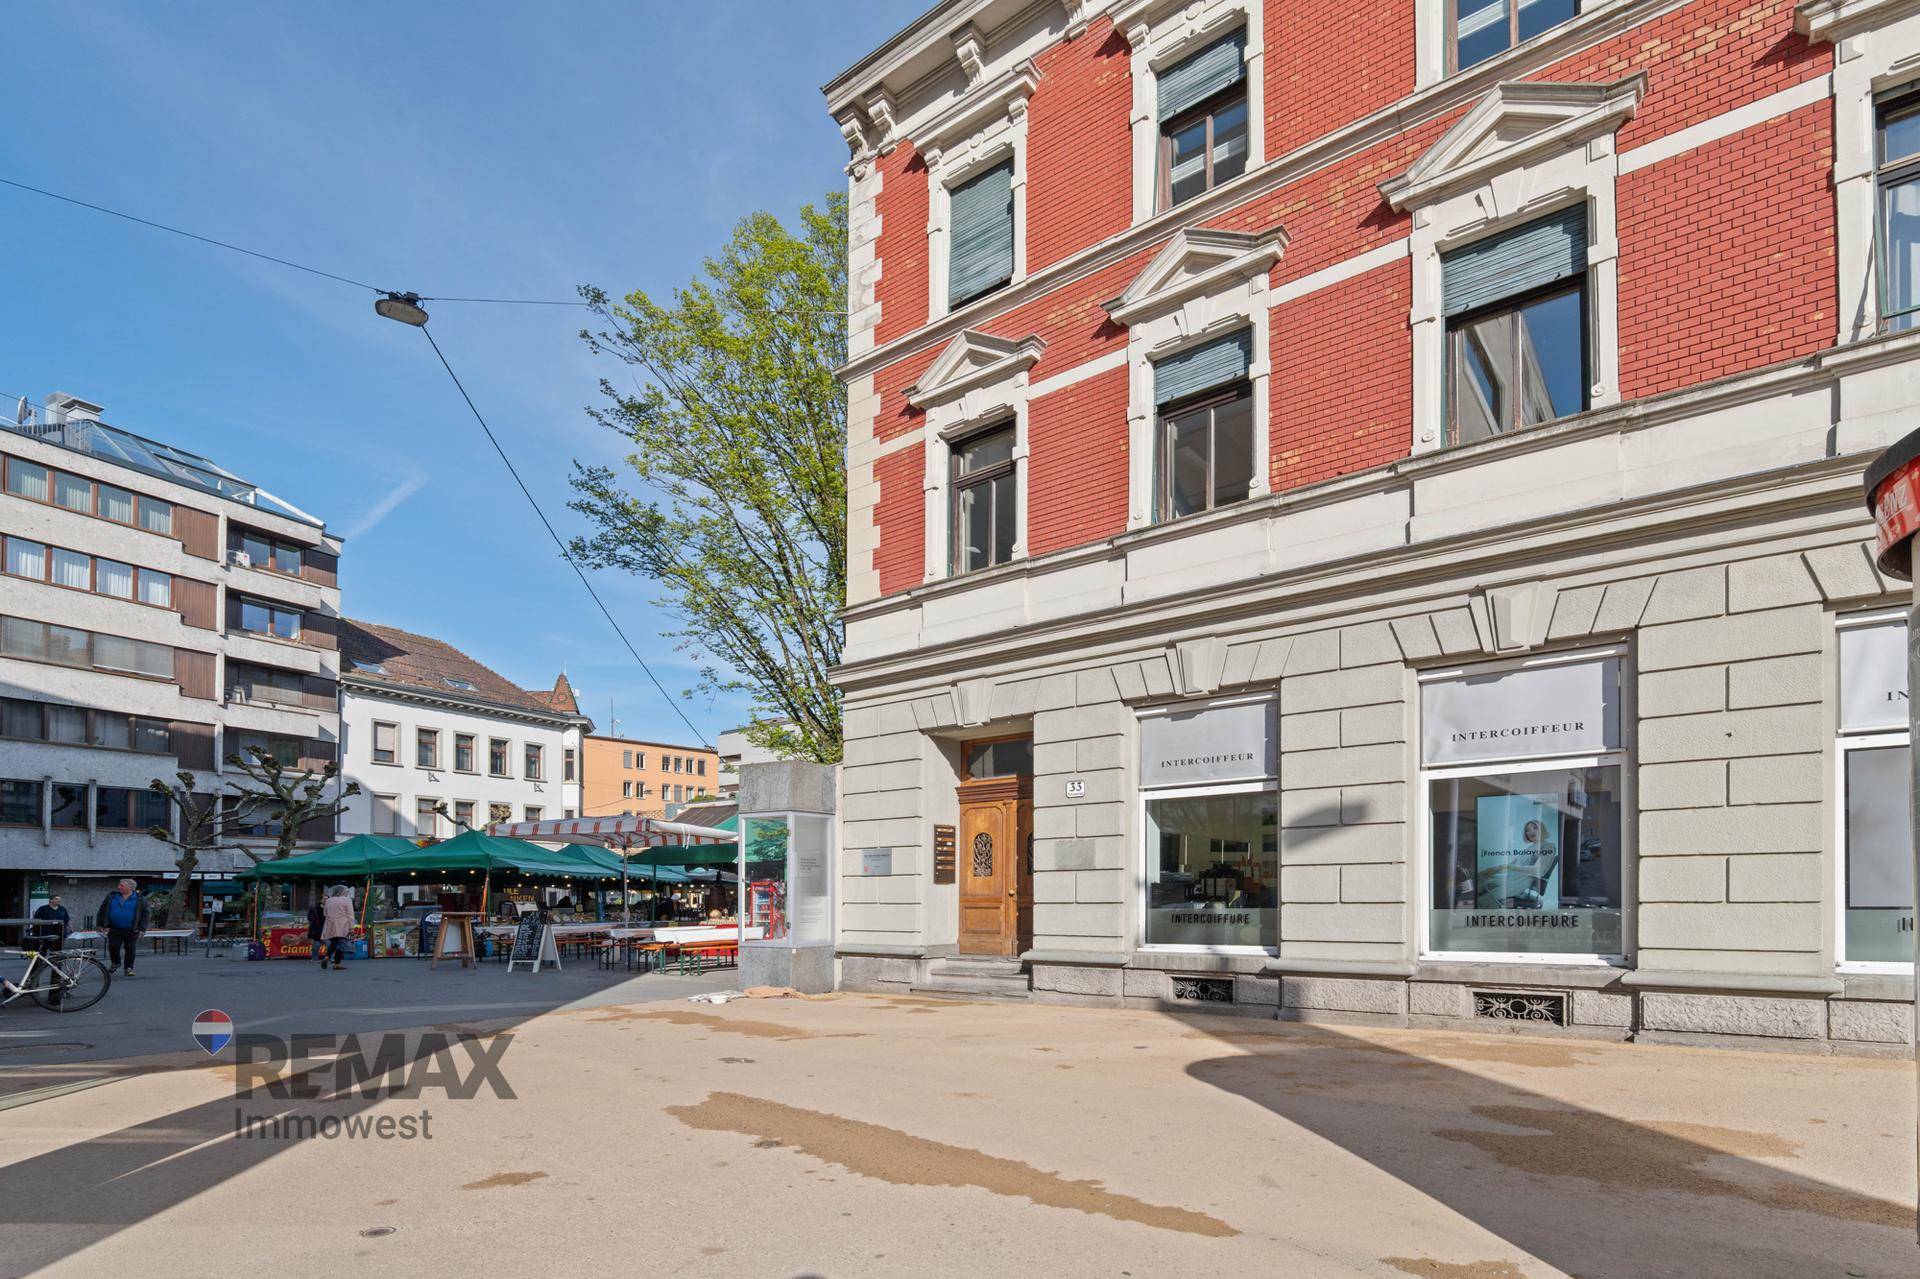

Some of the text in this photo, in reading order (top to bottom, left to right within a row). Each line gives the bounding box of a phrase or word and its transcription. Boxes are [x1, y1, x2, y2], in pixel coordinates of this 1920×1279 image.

[1452, 721, 1585, 742] INTERCOIFFEUR
[1161, 752, 1254, 768] INTERCOIFFEUR
[1069, 782, 1082, 792] 33
[1171, 913, 1250, 924] INTERCOIFFURE
[1466, 915, 1579, 928] INTERCOIFFURE
